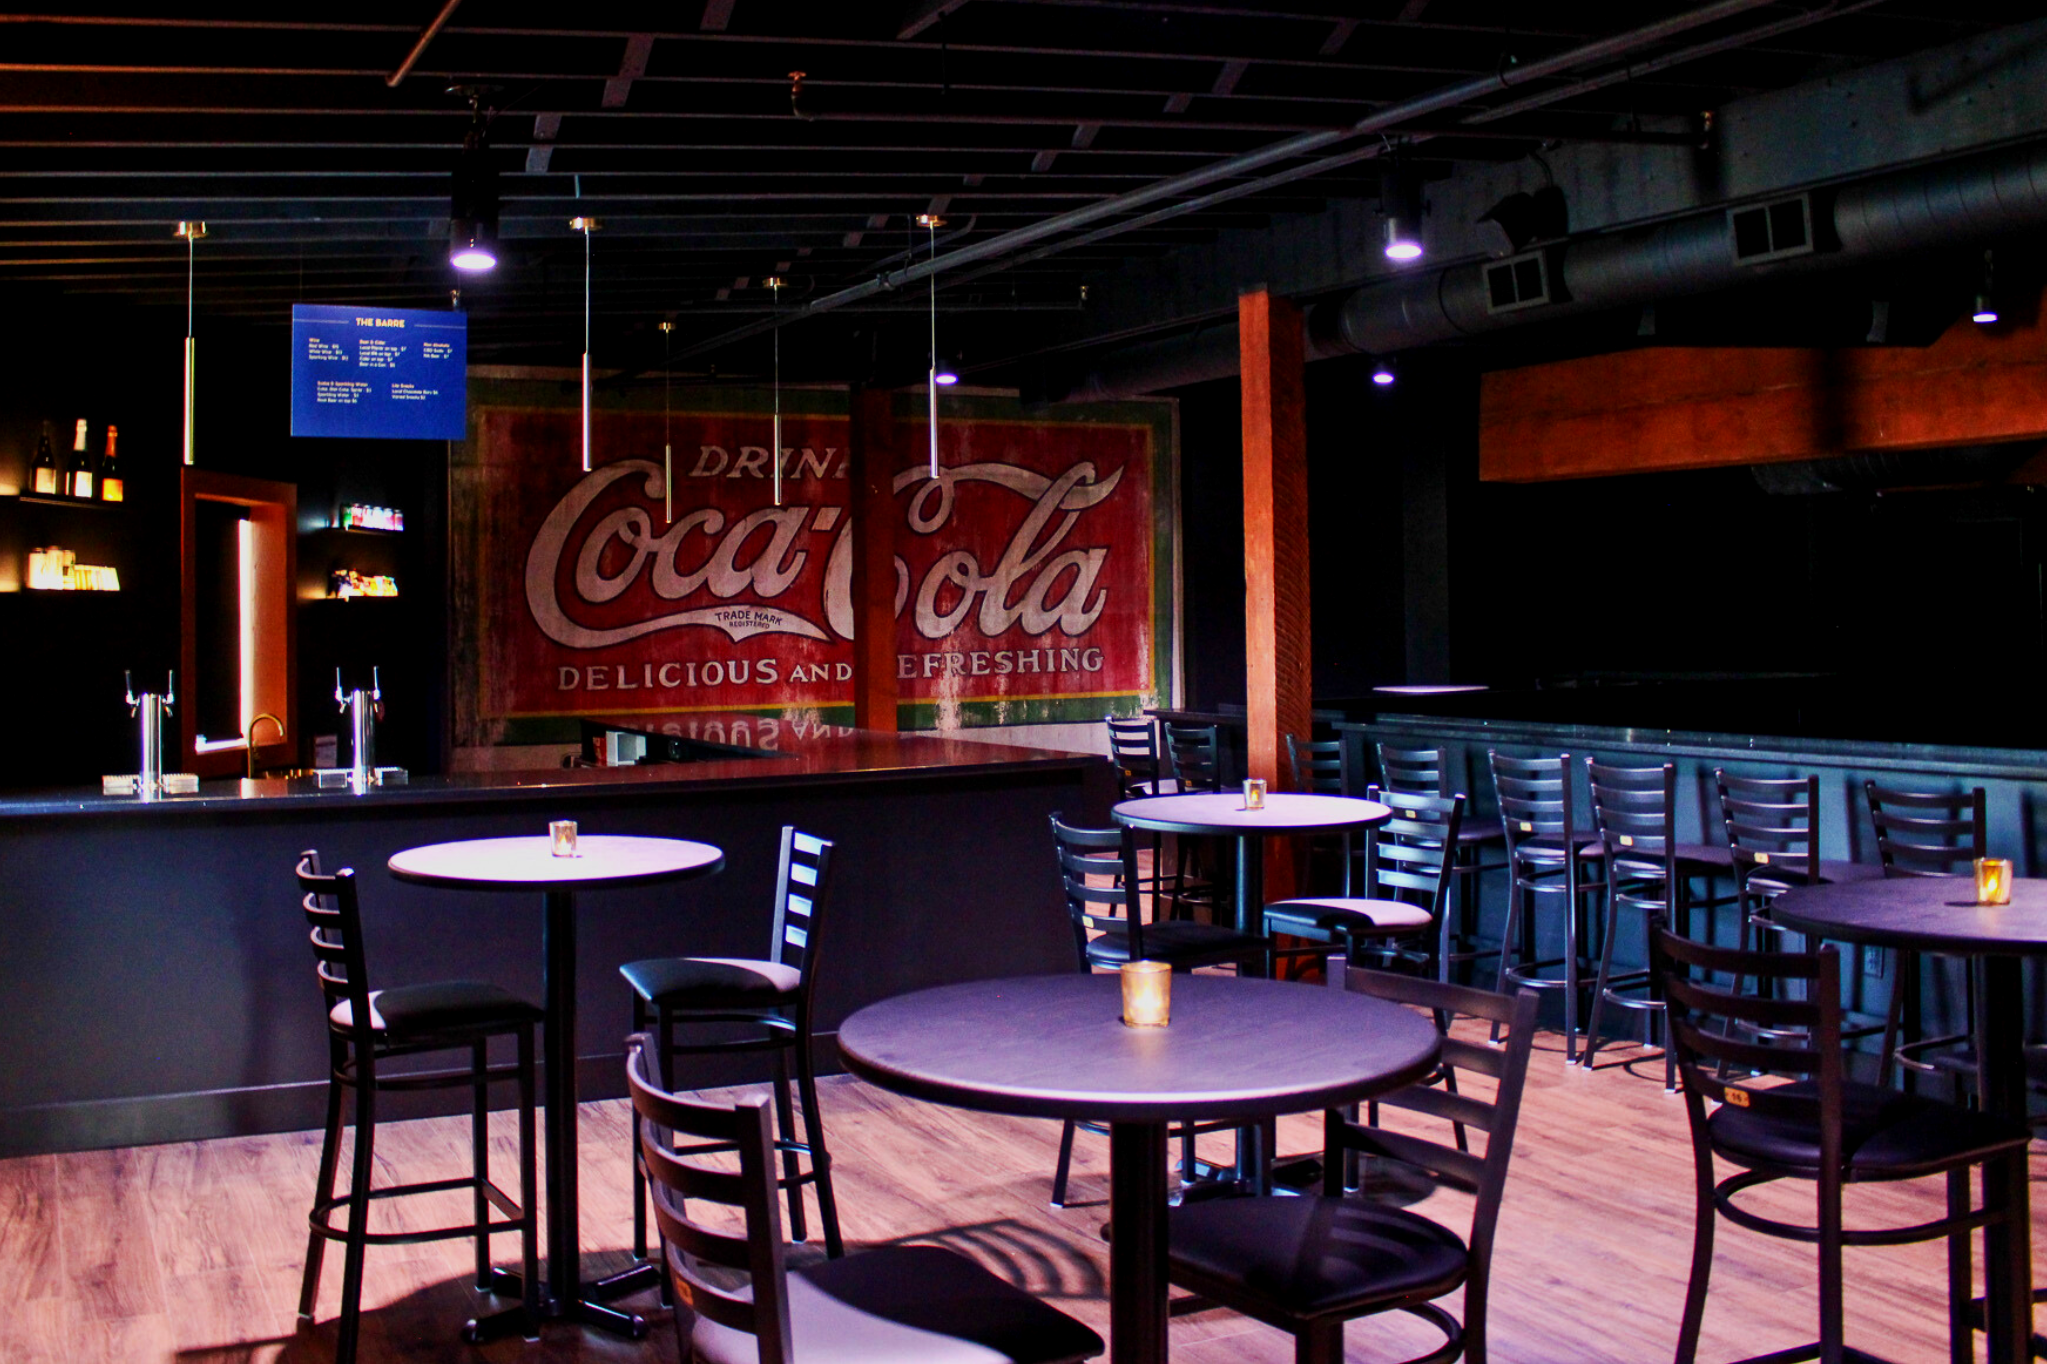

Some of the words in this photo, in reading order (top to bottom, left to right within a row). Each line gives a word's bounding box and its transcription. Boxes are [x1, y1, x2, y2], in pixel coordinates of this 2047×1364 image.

[356, 317, 373, 327] THE
[375, 318, 405, 328] BARRE
[714, 610, 751, 622] TRADE
[754, 611, 783, 626] MARK
[728, 620, 770, 630] REGISTERED
[557, 657, 779, 691] DELICIOUS
[788, 662, 853, 684] AND
[896, 648, 1104, 679] EFRESHING
